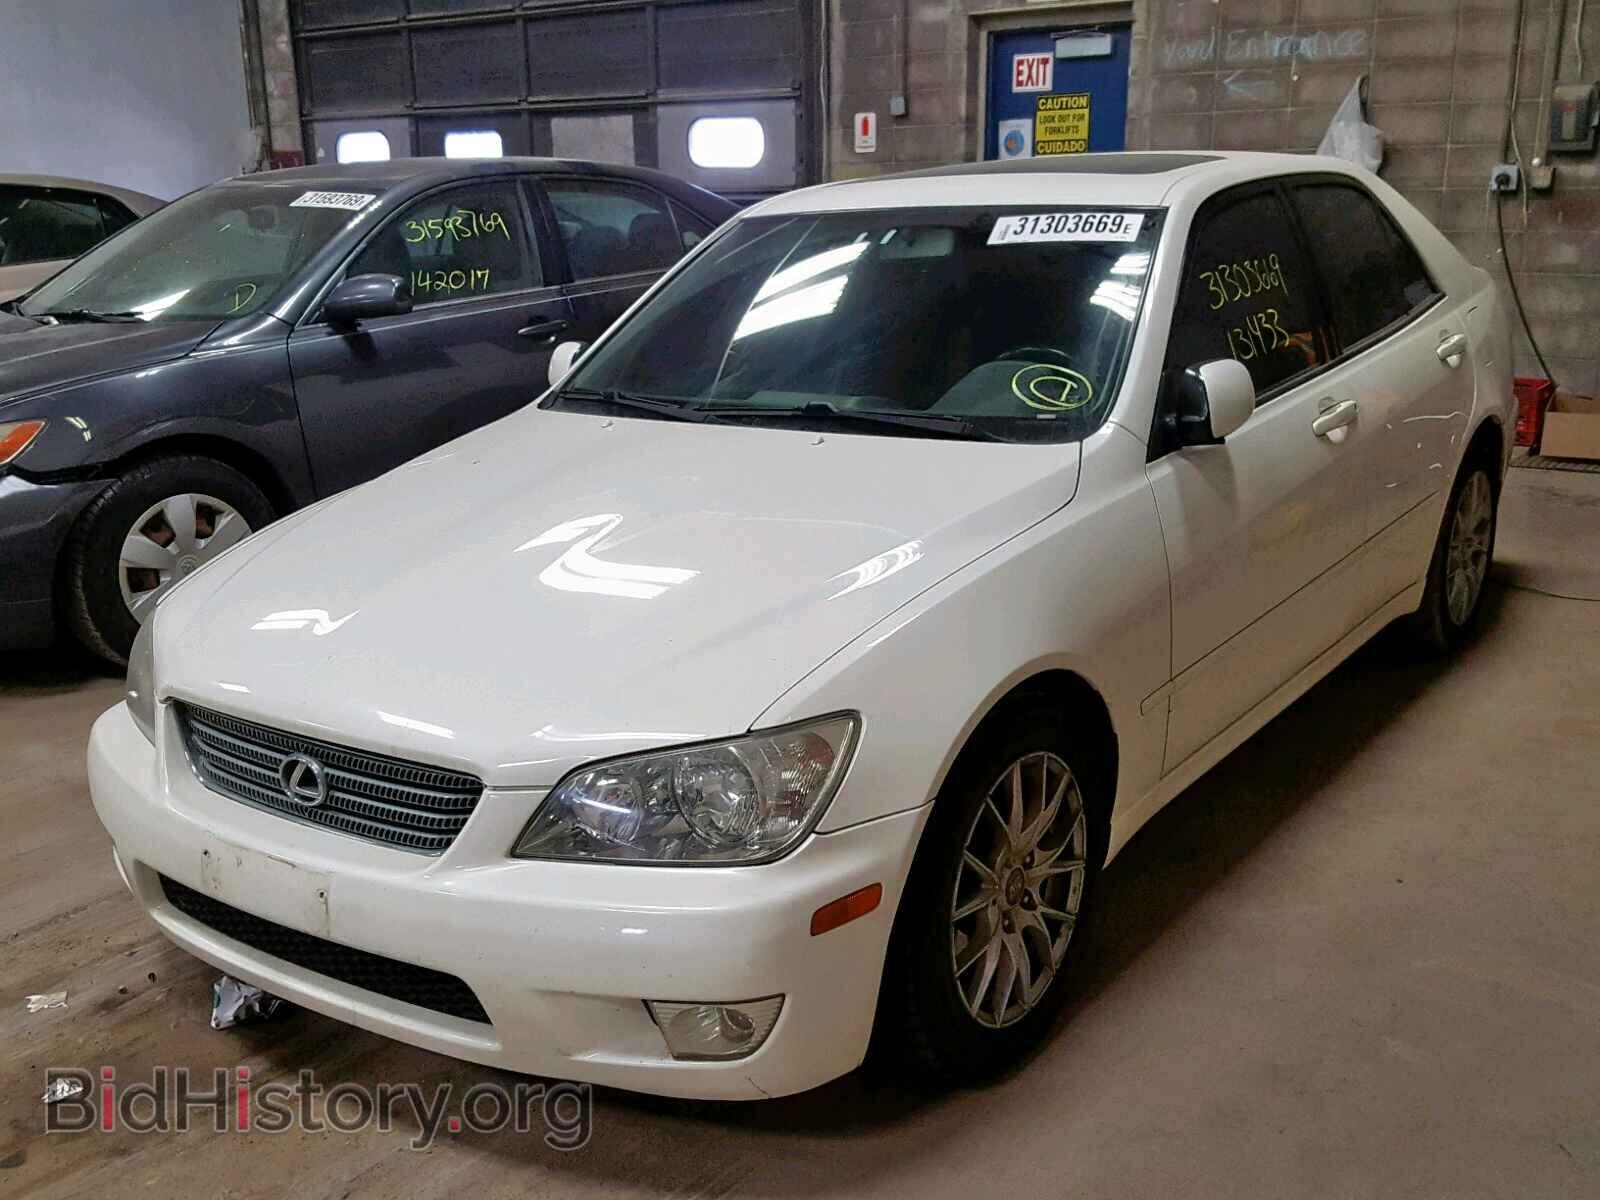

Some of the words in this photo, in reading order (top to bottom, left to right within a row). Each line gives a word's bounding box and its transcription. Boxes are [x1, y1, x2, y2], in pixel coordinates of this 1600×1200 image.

[1015, 56, 1050, 87] EXIT
[1038, 95, 1087, 110] CAUTION
[1039, 114, 1056, 124] LOOK
[1057, 113, 1071, 122] OUT
[1044, 125, 1080, 136] FORKLIFTS
[1037, 140, 1085, 153] CUIDADO
[406, 210, 510, 242] 31593769
[1013, 214, 1124, 236] 31303669
[411, 268, 490, 296] 142017
